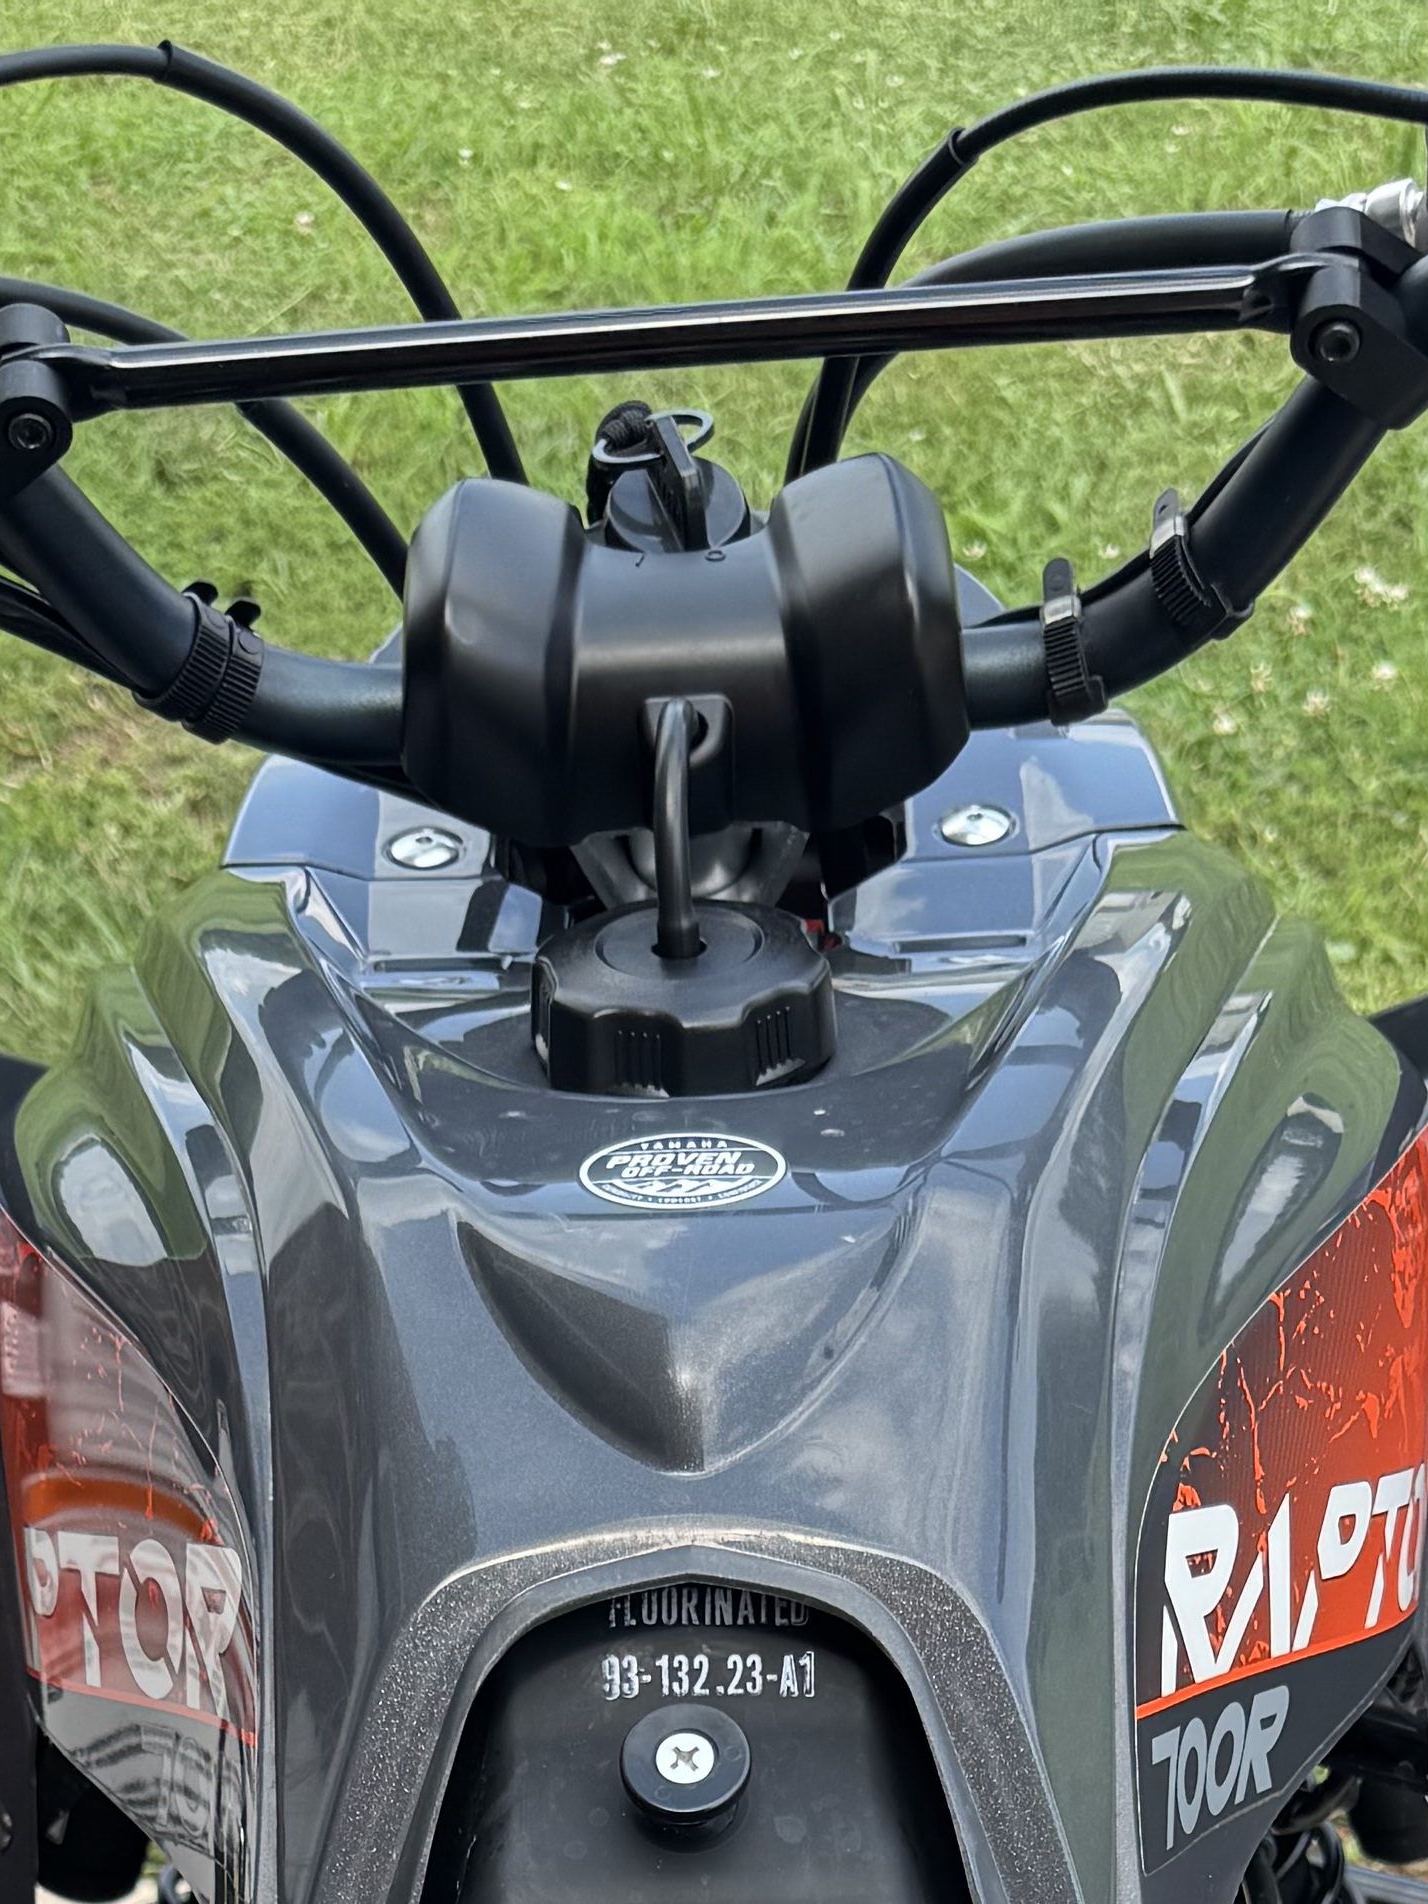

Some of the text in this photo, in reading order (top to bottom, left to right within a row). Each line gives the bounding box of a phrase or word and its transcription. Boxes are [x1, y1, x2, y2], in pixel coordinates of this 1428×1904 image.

[640, 1140, 728, 1150] YAMAHA
[606, 1151, 742, 1169] PROVEN
[621, 1162, 755, 1178] OFF-ROAD
[1152, 1684, 1292, 1850] 700R
